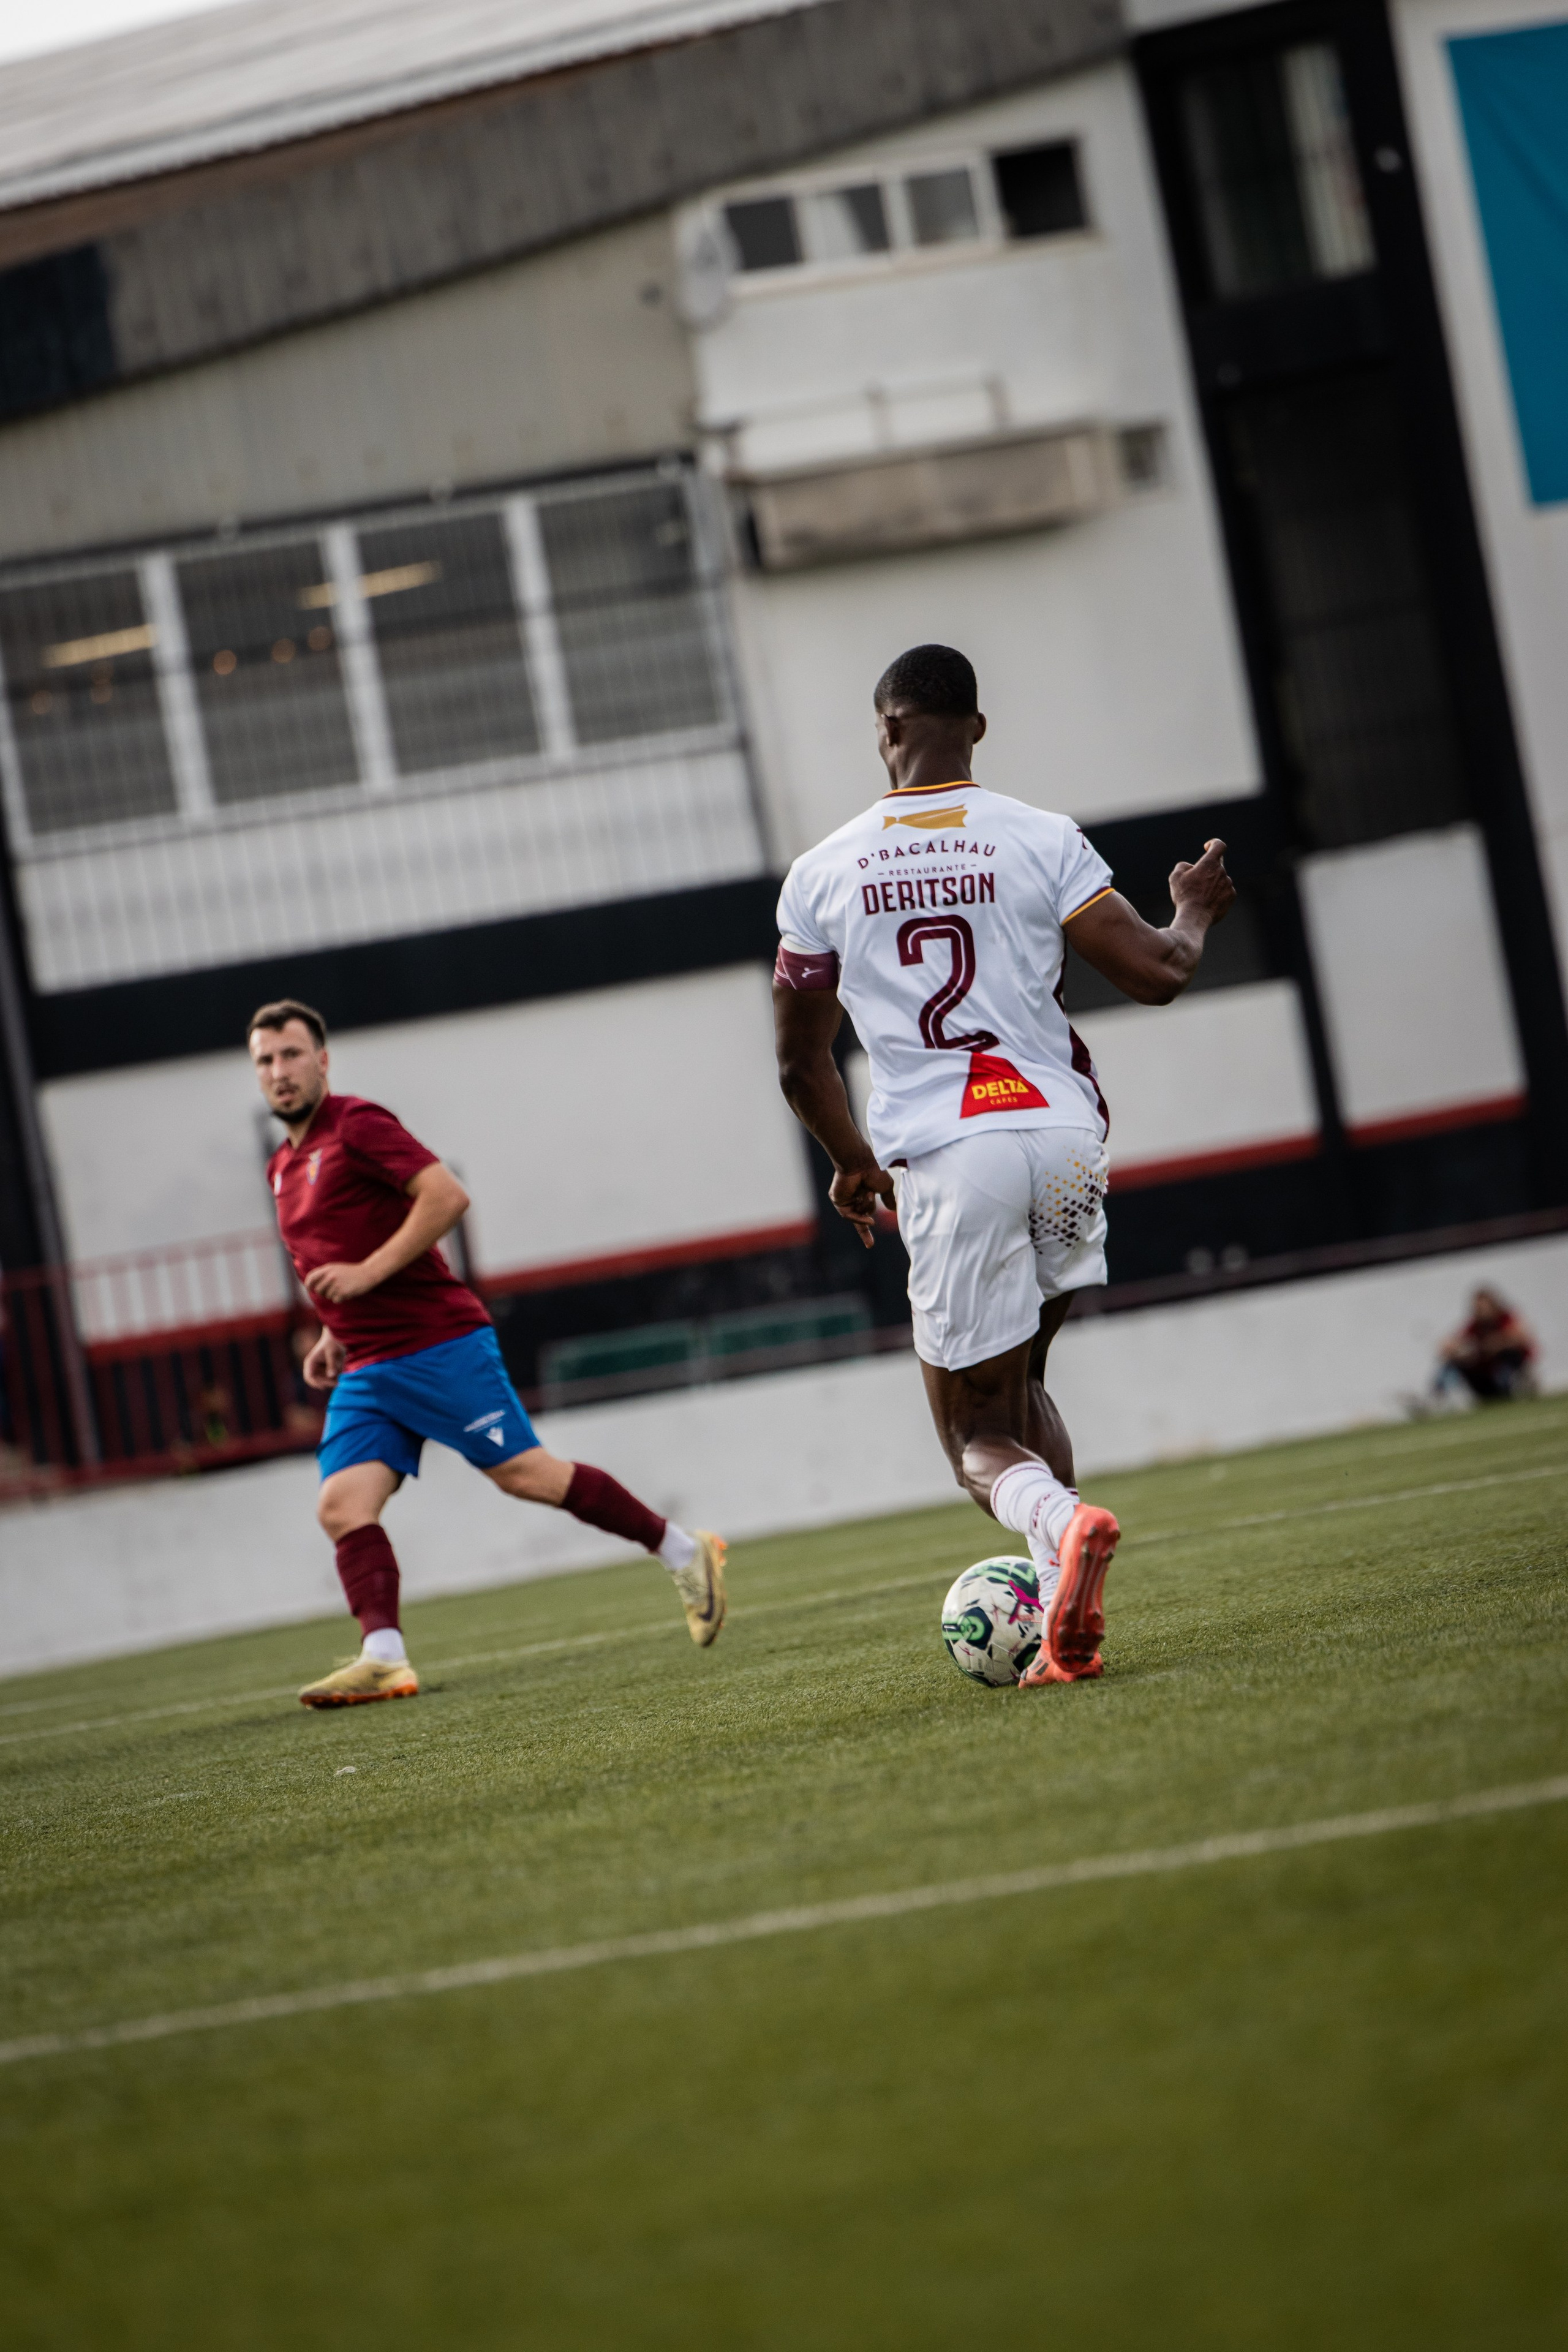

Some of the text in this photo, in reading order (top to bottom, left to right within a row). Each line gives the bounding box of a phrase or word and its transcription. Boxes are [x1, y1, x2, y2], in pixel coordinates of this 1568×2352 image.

[857, 840, 996, 870] D'BACALHAU
[889, 864, 967, 876] RESTAURANTE
[861, 872, 995, 916] DERITSON
[896, 914, 1000, 1054] 2
[971, 1078, 1029, 1100] DELTA
